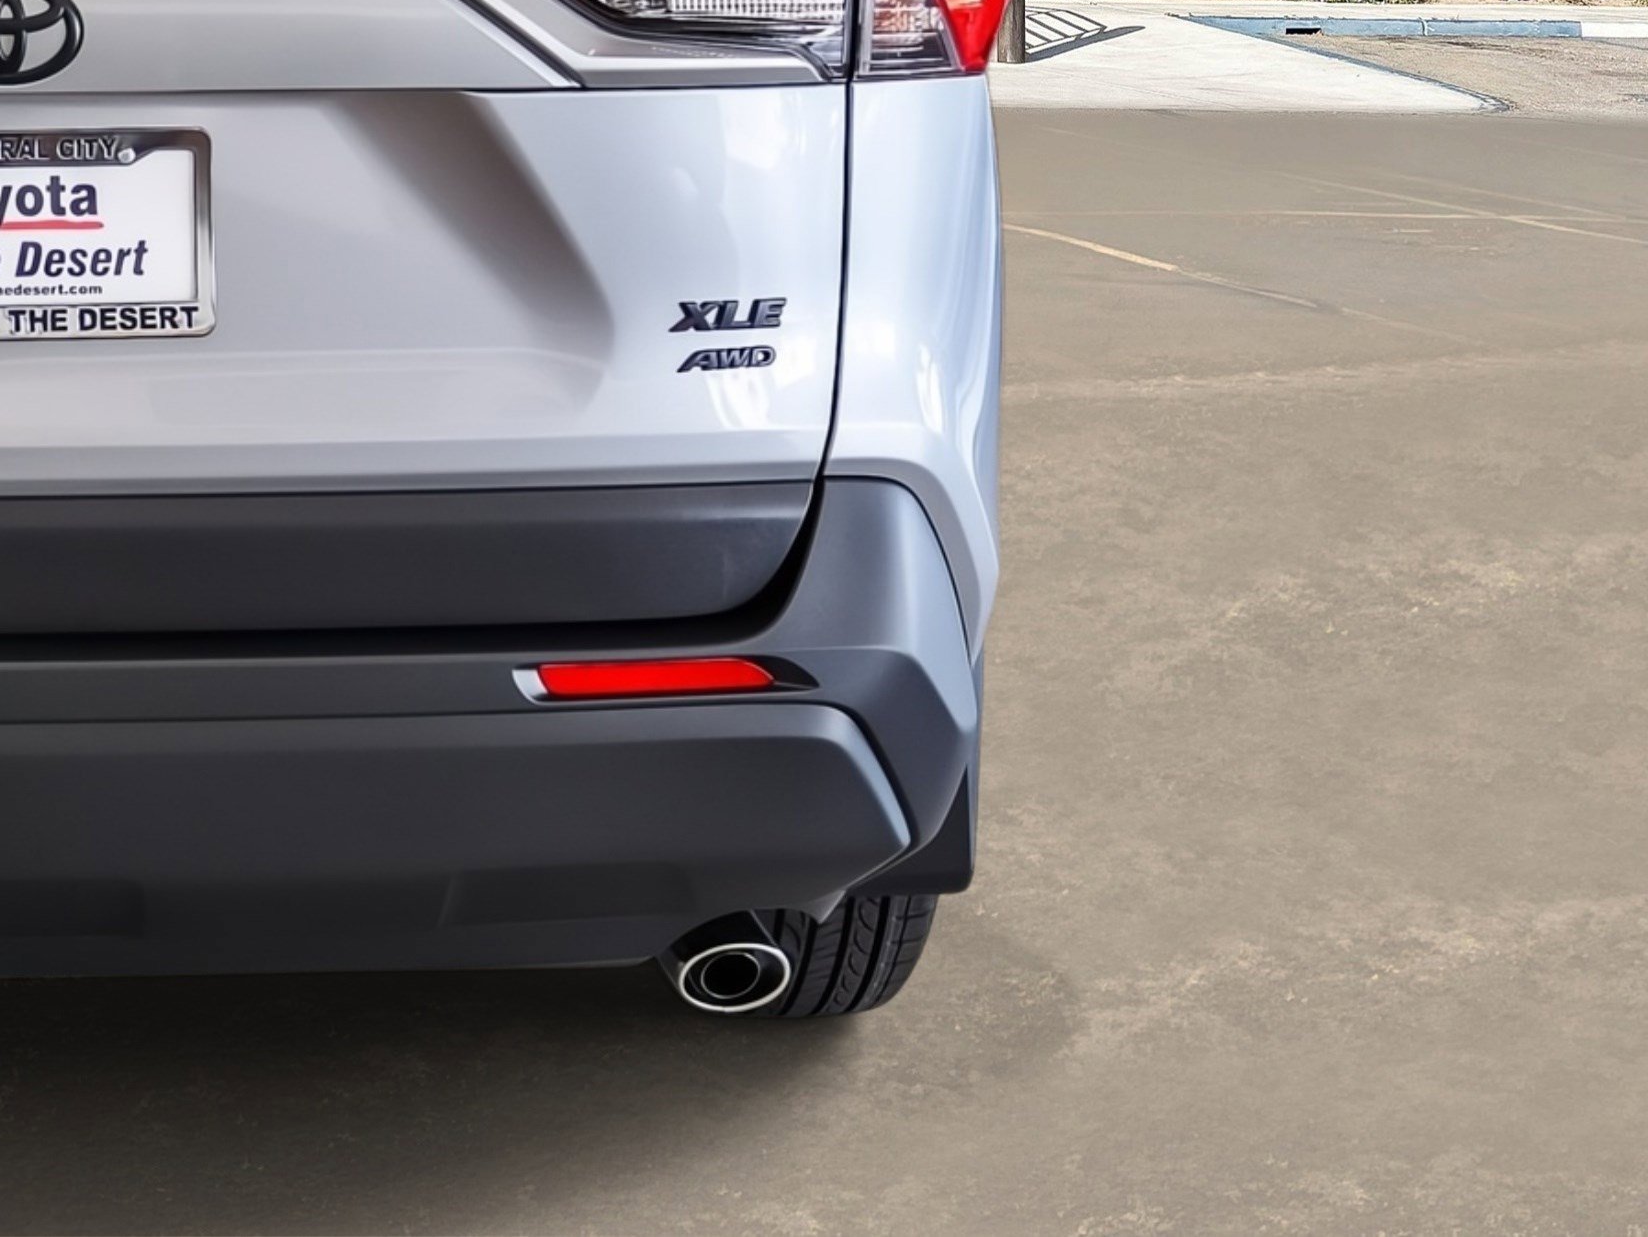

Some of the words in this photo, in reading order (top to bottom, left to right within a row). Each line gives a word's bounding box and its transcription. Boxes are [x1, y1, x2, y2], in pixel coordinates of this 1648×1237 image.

[55, 136, 118, 161] CITY
[14, 240, 149, 277] Desert
[8, 309, 69, 333] THE
[77, 306, 199, 331] DESERT
[668, 297, 788, 332] XLE
[676, 344, 777, 373] AWD
